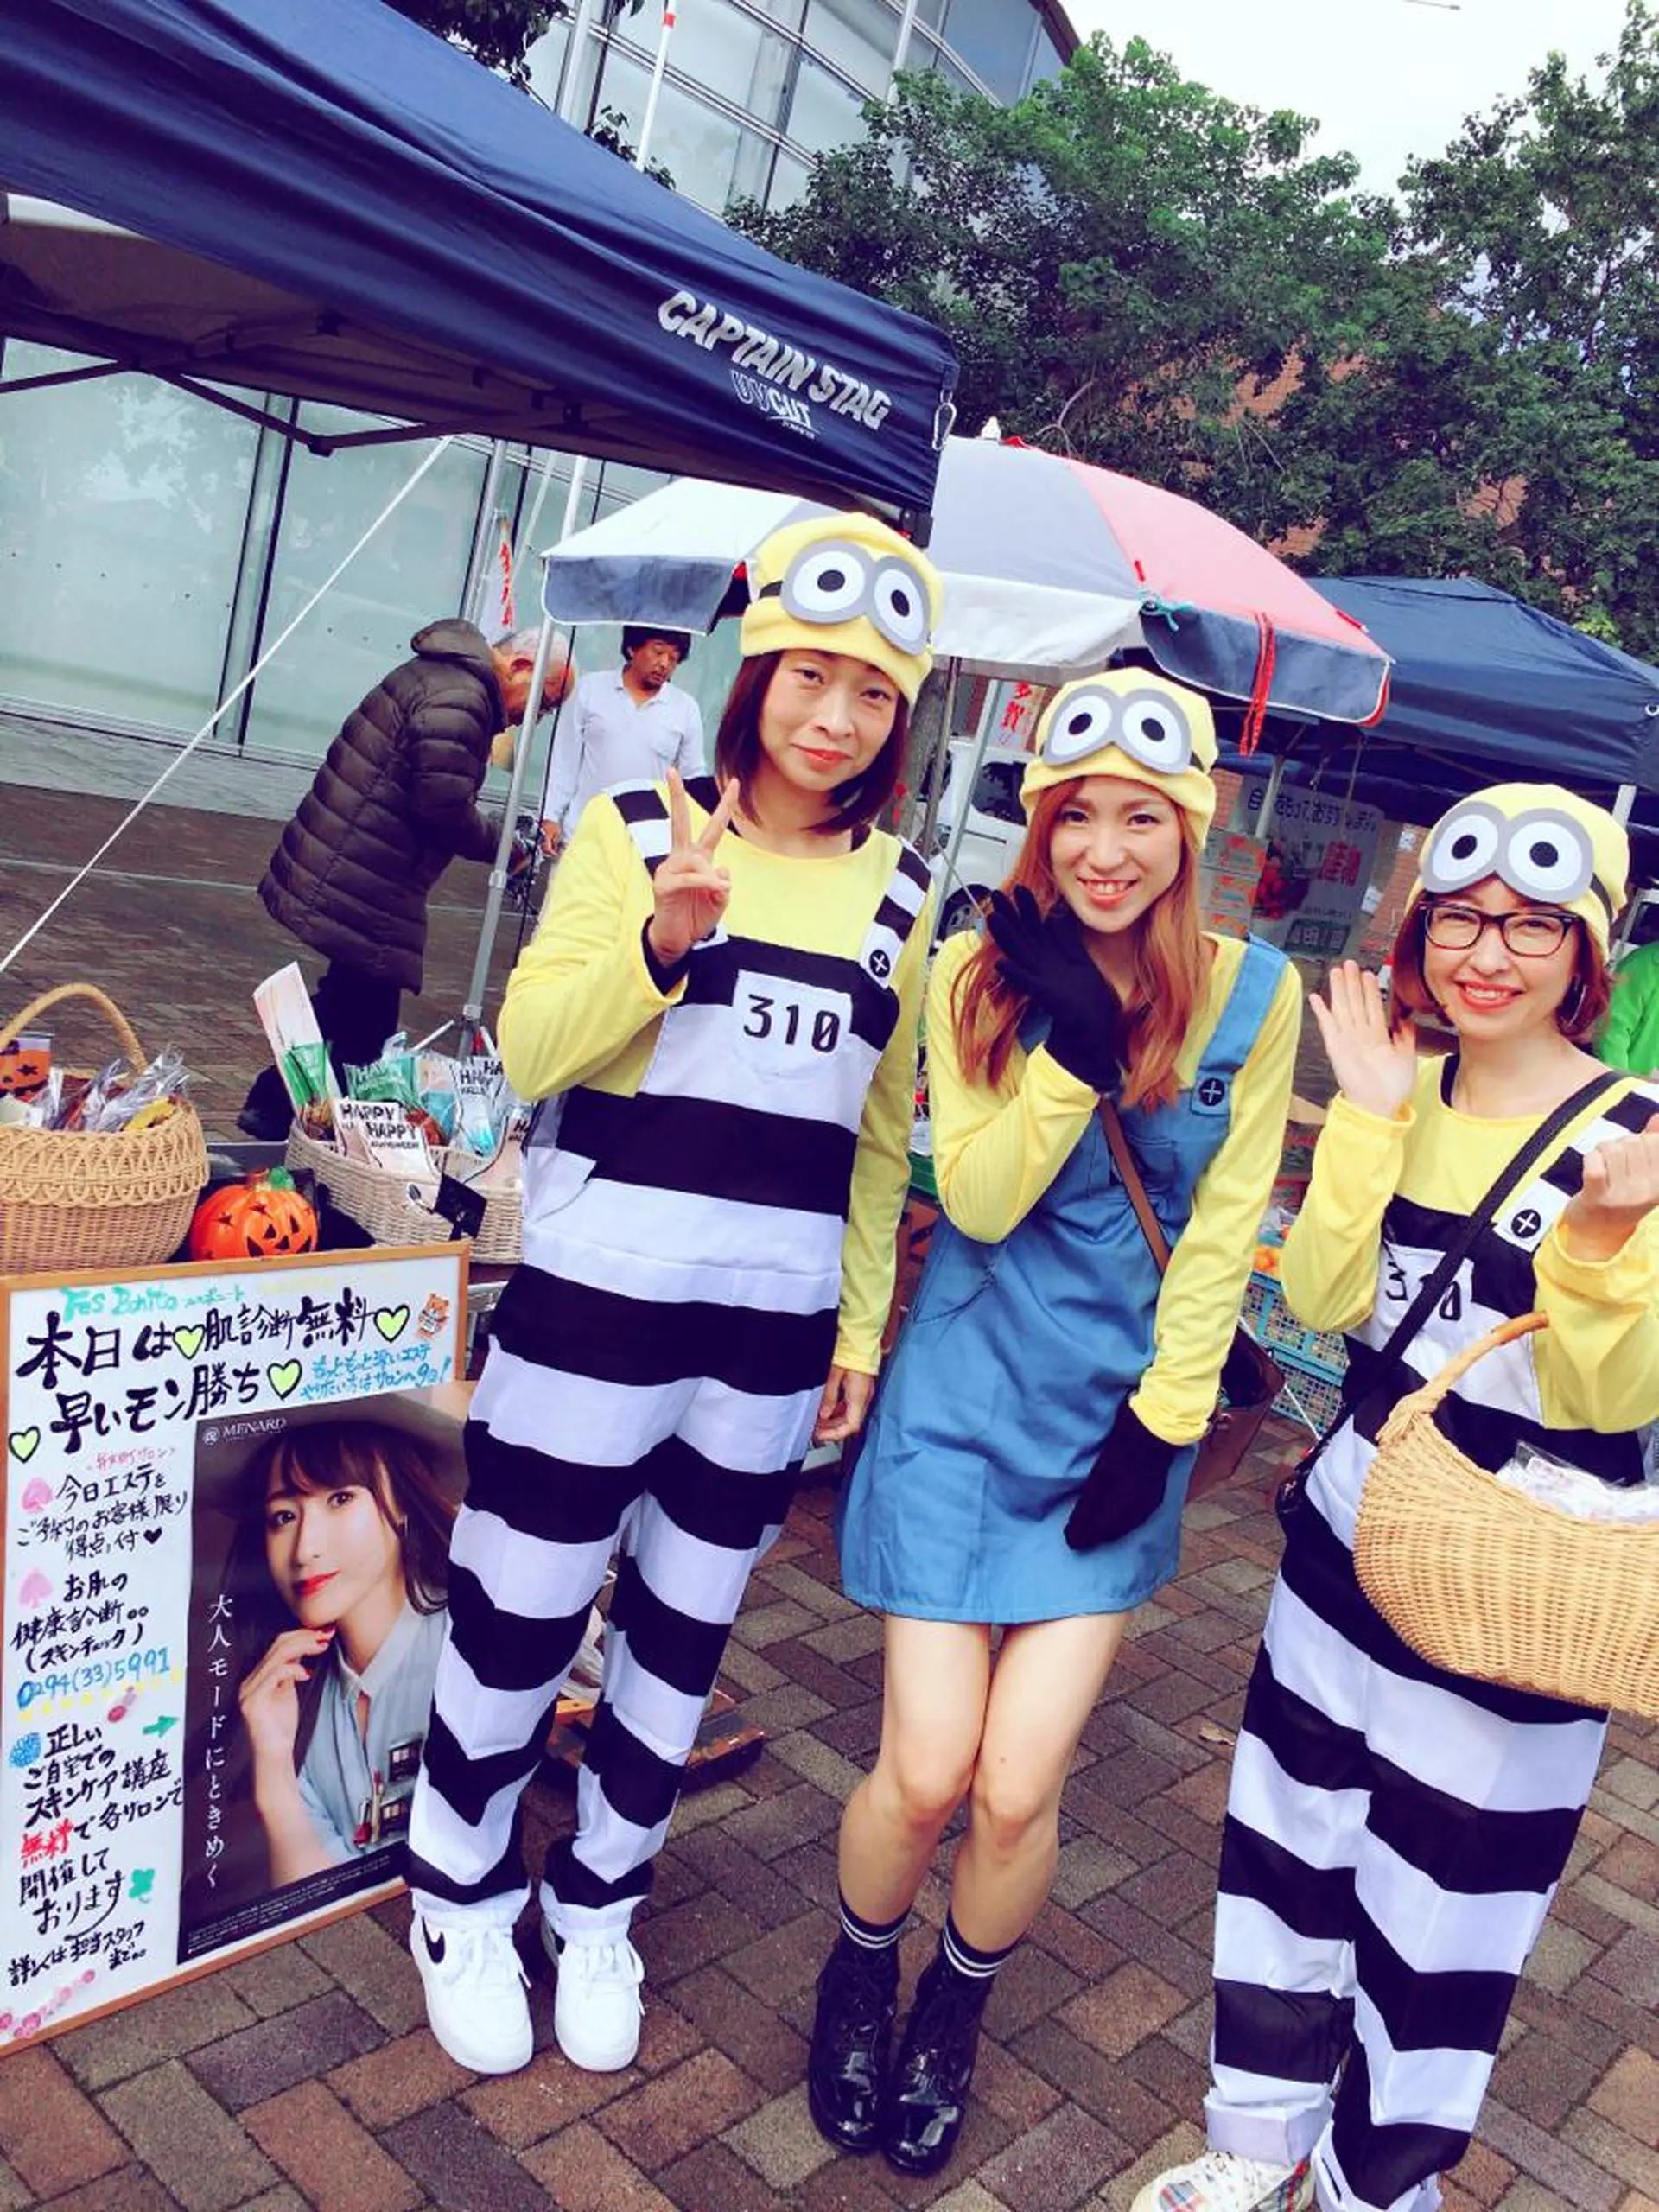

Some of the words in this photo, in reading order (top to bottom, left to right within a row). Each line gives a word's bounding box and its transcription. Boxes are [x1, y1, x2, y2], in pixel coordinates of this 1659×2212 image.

[657, 290, 817, 391] CAPTAIN
[808, 365, 892, 431] STAG
[743, 994, 840, 1053] 310
[340, 1103, 394, 1121] HAPPY
[366, 1122, 416, 1139] HAPPY
[16, 1310, 174, 1389] 本日は
[204, 1287, 373, 1351] 肌診断無料
[49, 1361, 262, 1455] 早いモン勝ち
[222, 1417, 288, 1437] MENARD
[63, 1569, 129, 1603] お肌の
[24, 1744, 117, 1789] ご自宅での
[44, 1723, 103, 1758] 正しい
[206, 1593, 234, 1888] 大人モードにときめく
[19, 1847, 111, 1907] 開催して
[32, 1869, 126, 1942] おります
